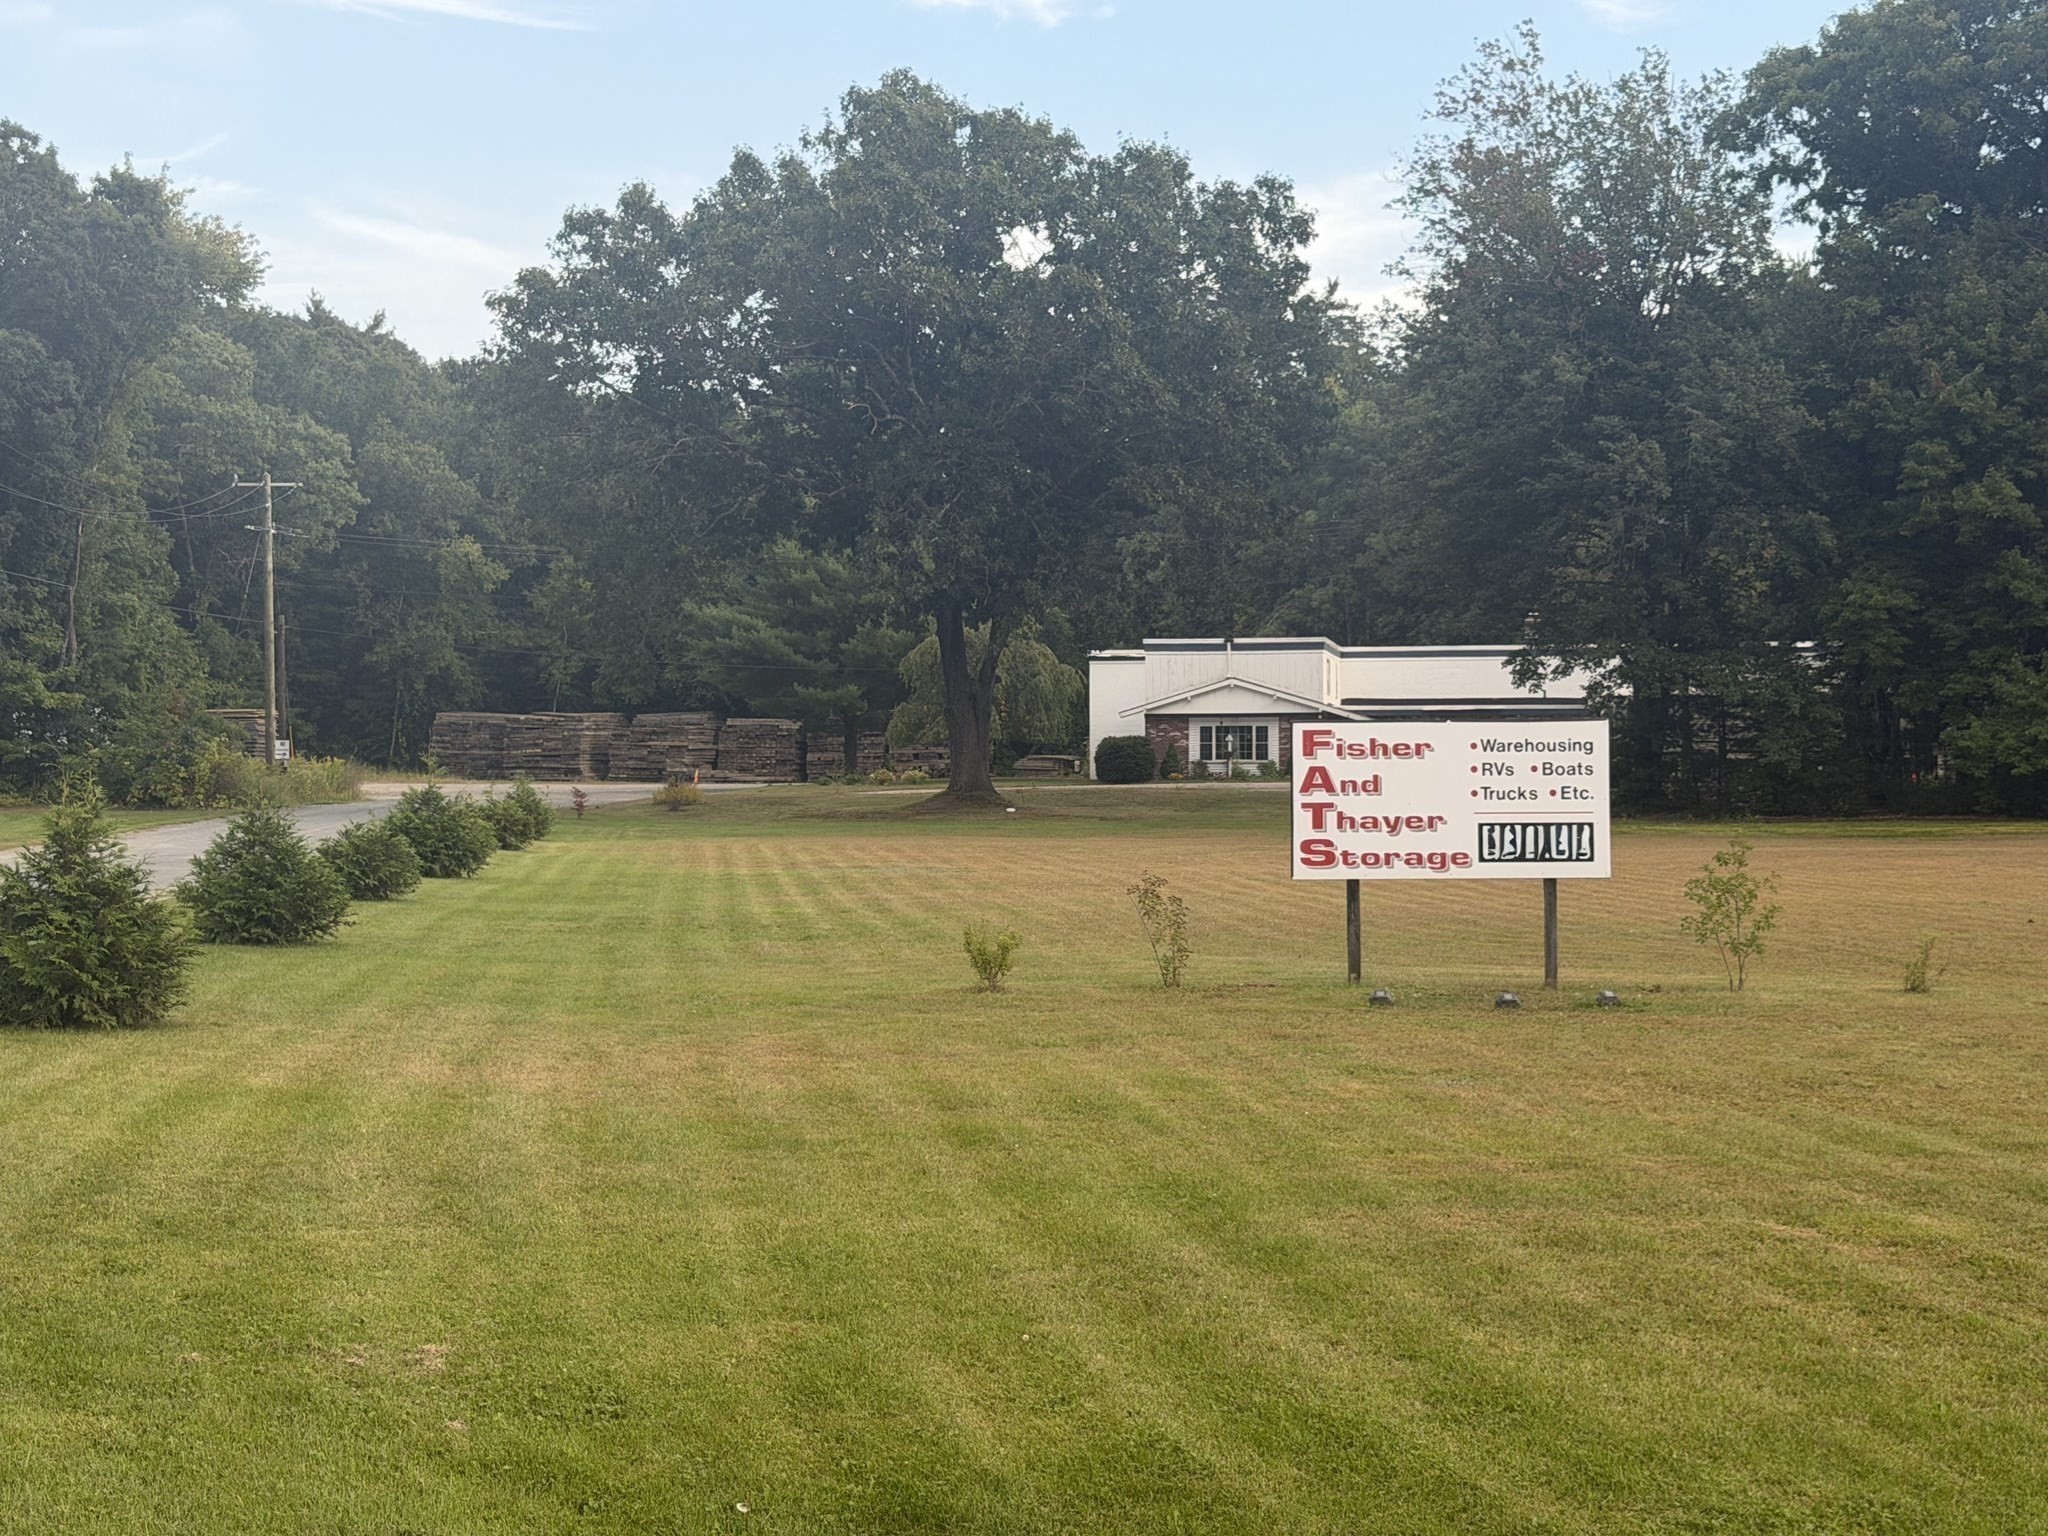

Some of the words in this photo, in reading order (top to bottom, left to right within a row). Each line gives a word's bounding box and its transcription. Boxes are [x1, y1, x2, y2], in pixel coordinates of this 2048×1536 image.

[1301, 729, 1434, 759] Fisher
[1481, 738, 1594, 754] Warehousing
[1299, 766, 1382, 795] And
[1482, 762, 1515, 776] RVs
[1542, 762, 1594, 776] Boats
[1480, 787, 1538, 800] Trucks
[1561, 786, 1594, 800] Etc.
[1301, 802, 1447, 836] Thayer
[1299, 839, 1472, 872] Storage
